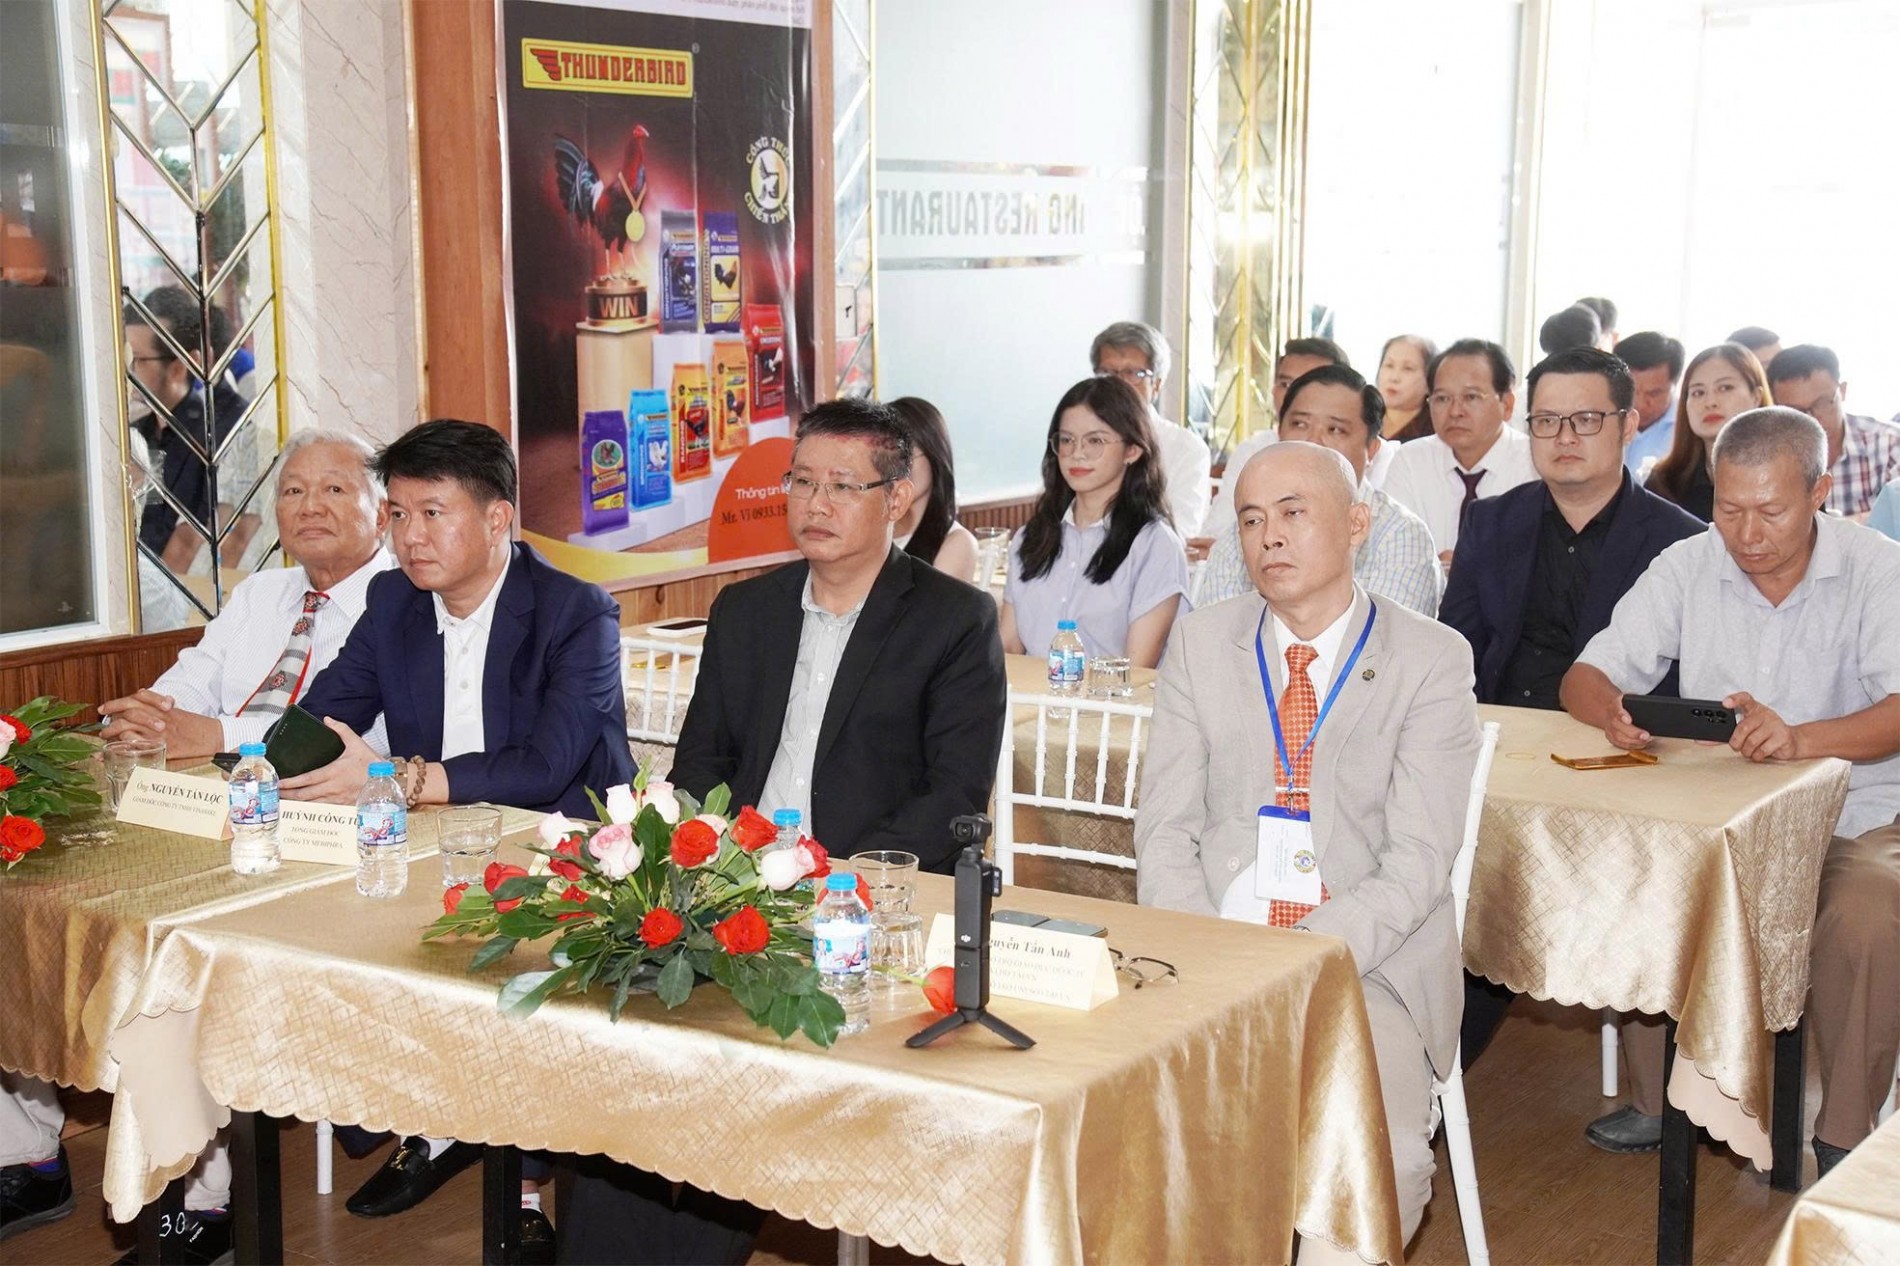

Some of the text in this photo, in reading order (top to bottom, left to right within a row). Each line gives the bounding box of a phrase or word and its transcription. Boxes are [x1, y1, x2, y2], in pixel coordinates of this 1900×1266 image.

[561, 50, 686, 86] THUNDERBIRD
[600, 297, 638, 319] WIN
[735, 487, 767, 500] Thông
[767, 485, 780, 496] tin
[720, 511, 738, 525] Mr.
[752, 503, 788, 520] 0933.15
[204, 793, 224, 805] LỌC
[317, 812, 347, 825] CÔNG
[989, 936, 1071, 959] guyễn Tấn Anh
